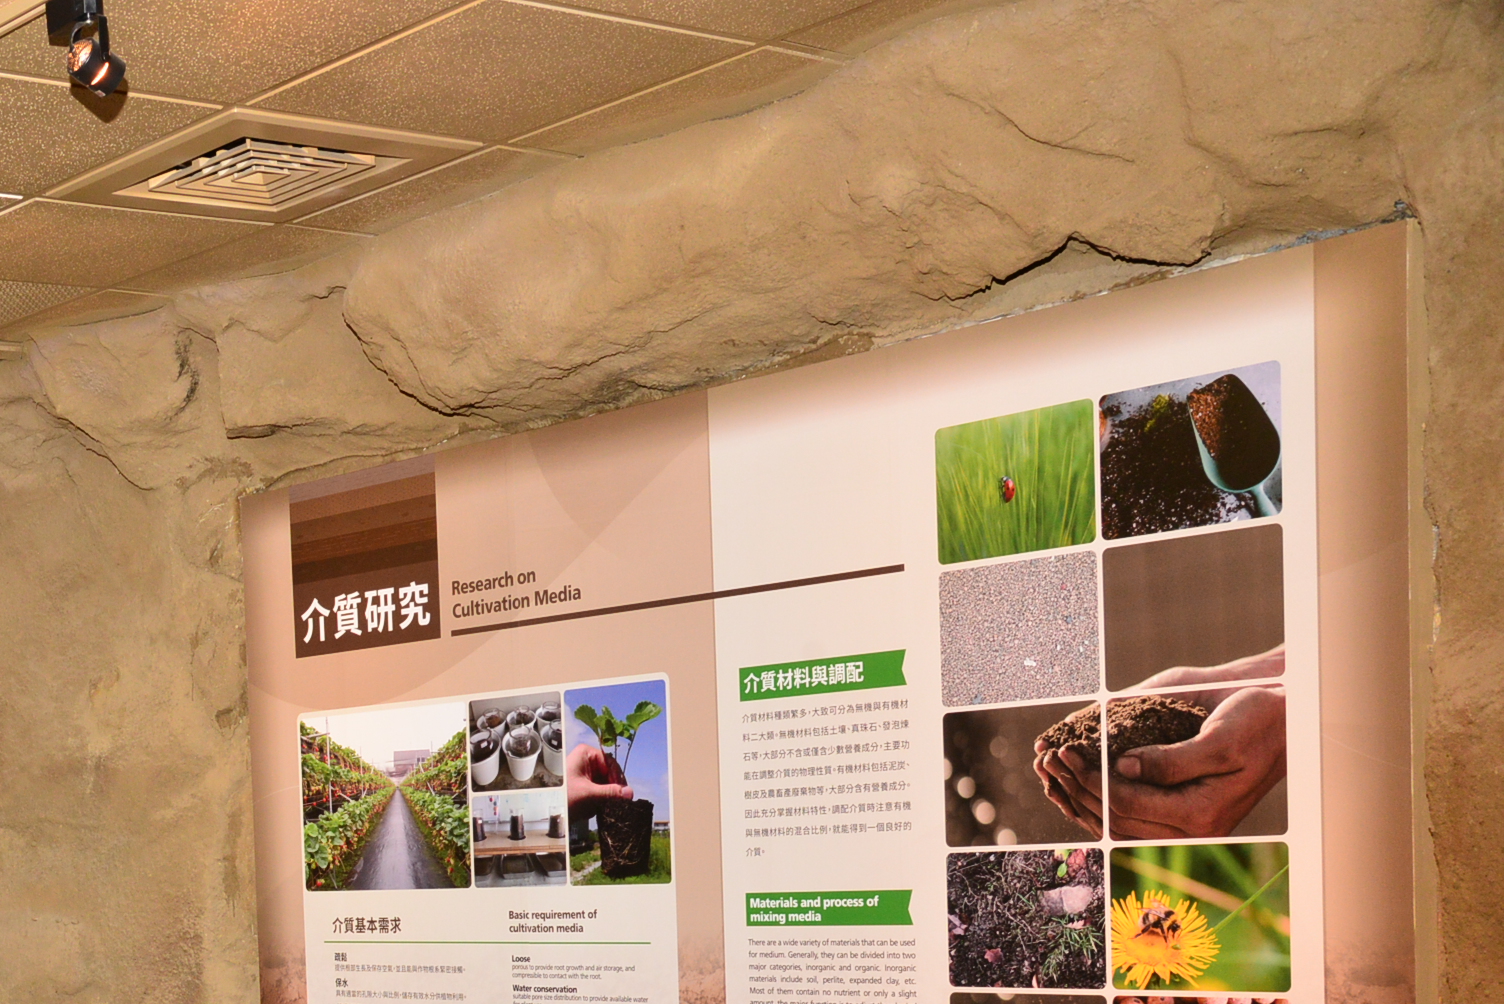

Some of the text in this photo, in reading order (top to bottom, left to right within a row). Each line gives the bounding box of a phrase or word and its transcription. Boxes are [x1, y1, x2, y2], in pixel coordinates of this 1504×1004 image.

[451, 569, 536, 596] Research on
[452, 585, 582, 619] Cultivation Media
[301, 581, 431, 644] 介質研究
[743, 661, 864, 695] 介質材料與調配
[746, 847, 766, 858] 介質。
[750, 895, 879, 909] Materials and process of
[508, 909, 597, 921] Basic requirement of
[750, 911, 822, 924] mixing media
[332, 916, 402, 934] 介質基本需求
[509, 923, 584, 933] cultivation media
[748, 938, 766, 946] There
[783, 938, 799, 946] wide
[799, 939, 821, 948] variety
[821, 938, 829, 946] of
[830, 938, 860, 946] materials
[861, 938, 875, 946] that
[889, 938, 899, 947] be
[899, 938, 916, 947] used
[511, 955, 531, 963] Loose
[748, 950, 758, 958] for
[759, 950, 786, 959] medium.
[787, 950, 819, 959] Generally,
[820, 951, 835, 960] they
[849, 951, 859, 959] be
[860, 951, 885, 959] divided
[886, 951, 901, 959] into
[748, 963, 916, 973] major categories, inorganic and organic. Inorganic
[335, 977, 349, 988] 保水
[749, 975, 777, 983] materials
[780, 975, 803, 983] include
[806, 975, 819, 984] soil,
[822, 976, 845, 985] perlite,
[849, 976, 883, 985] expanded
[885, 977, 900, 986] clay,
[512, 984, 532, 992] Water
[749, 987, 765, 995] Most
[767, 987, 775, 995] of
[776, 987, 794, 995] them
[795, 988, 820, 996] contain
[834, 989, 861, 997] nutrient
[873, 989, 889, 999] only
[898, 989, 917, 999] slight
